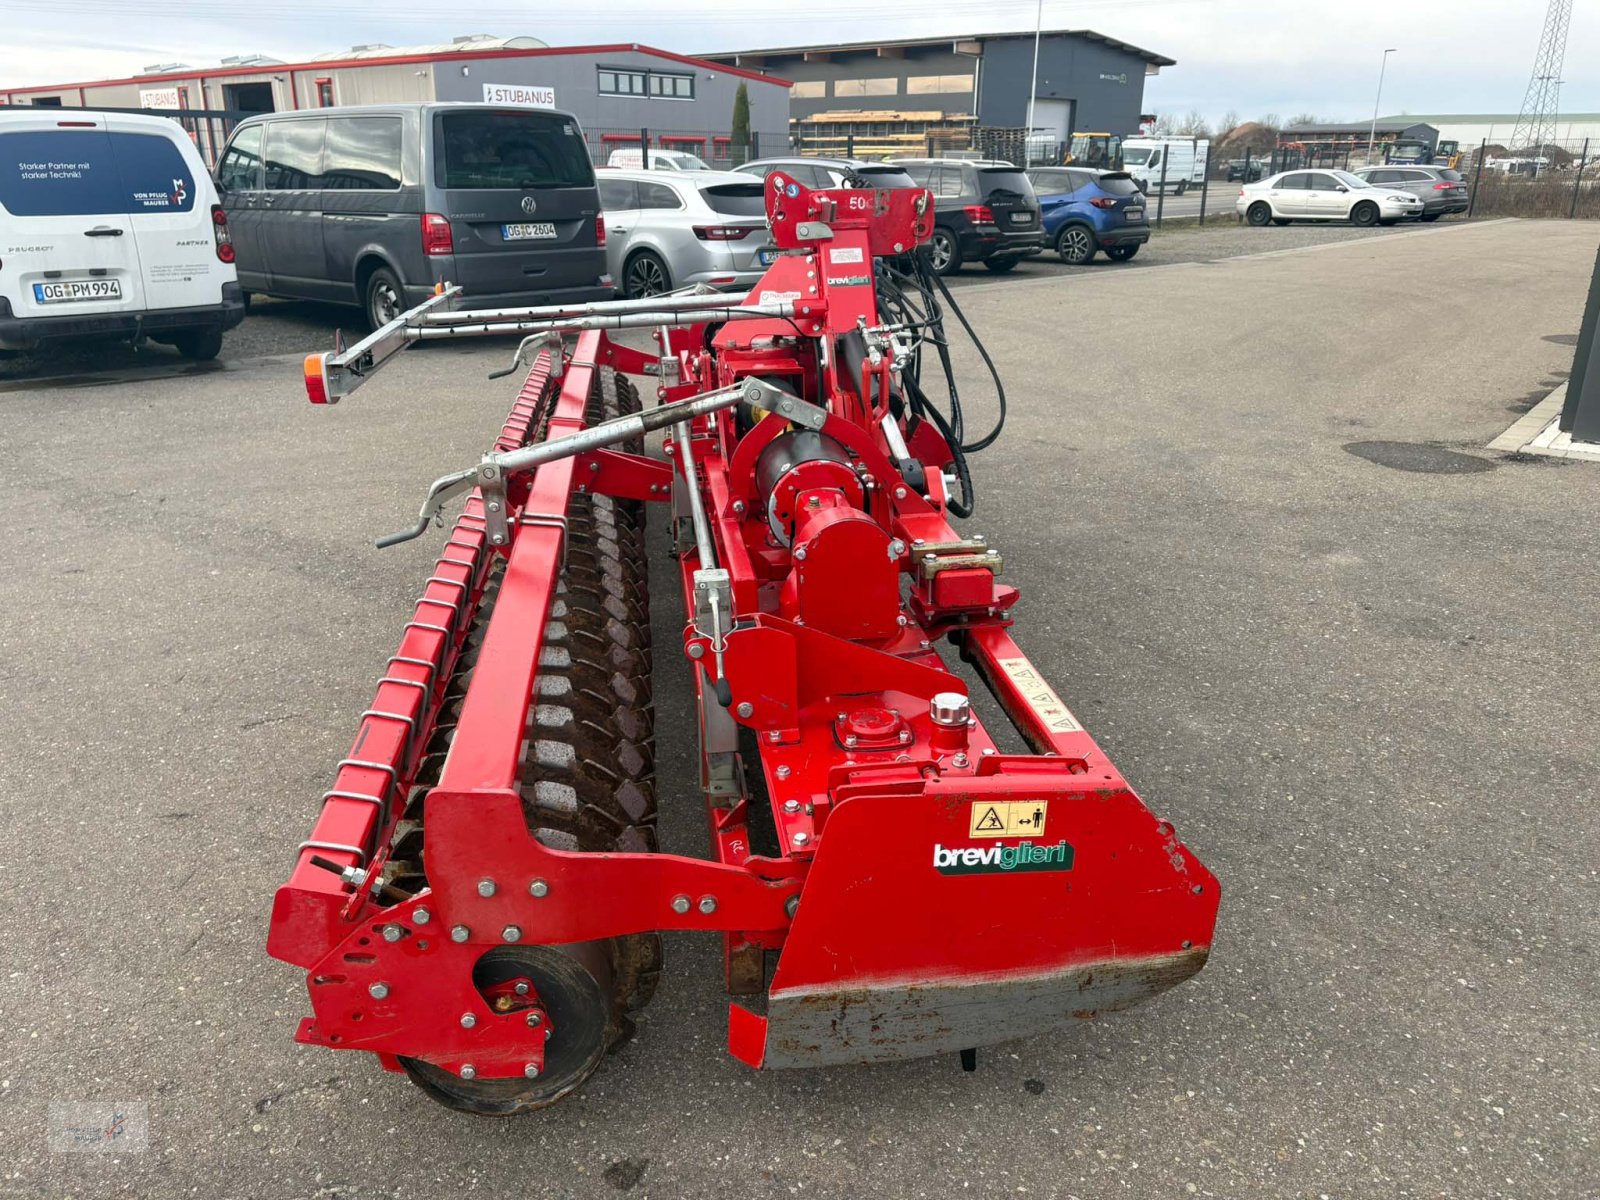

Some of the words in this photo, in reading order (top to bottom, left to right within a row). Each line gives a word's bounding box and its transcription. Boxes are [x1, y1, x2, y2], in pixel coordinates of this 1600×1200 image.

[495, 89, 553, 104] STUBANUS
[18, 162, 46, 170] Starker
[48, 162, 76, 170] Partner
[507, 225, 520, 236] OG
[525, 225, 532, 236] C
[533, 224, 554, 235] 2604
[44, 285, 64, 298] OG
[71, 283, 91, 297] PM
[92, 281, 119, 295] 994
[933, 840, 1067, 870] breviglieri
